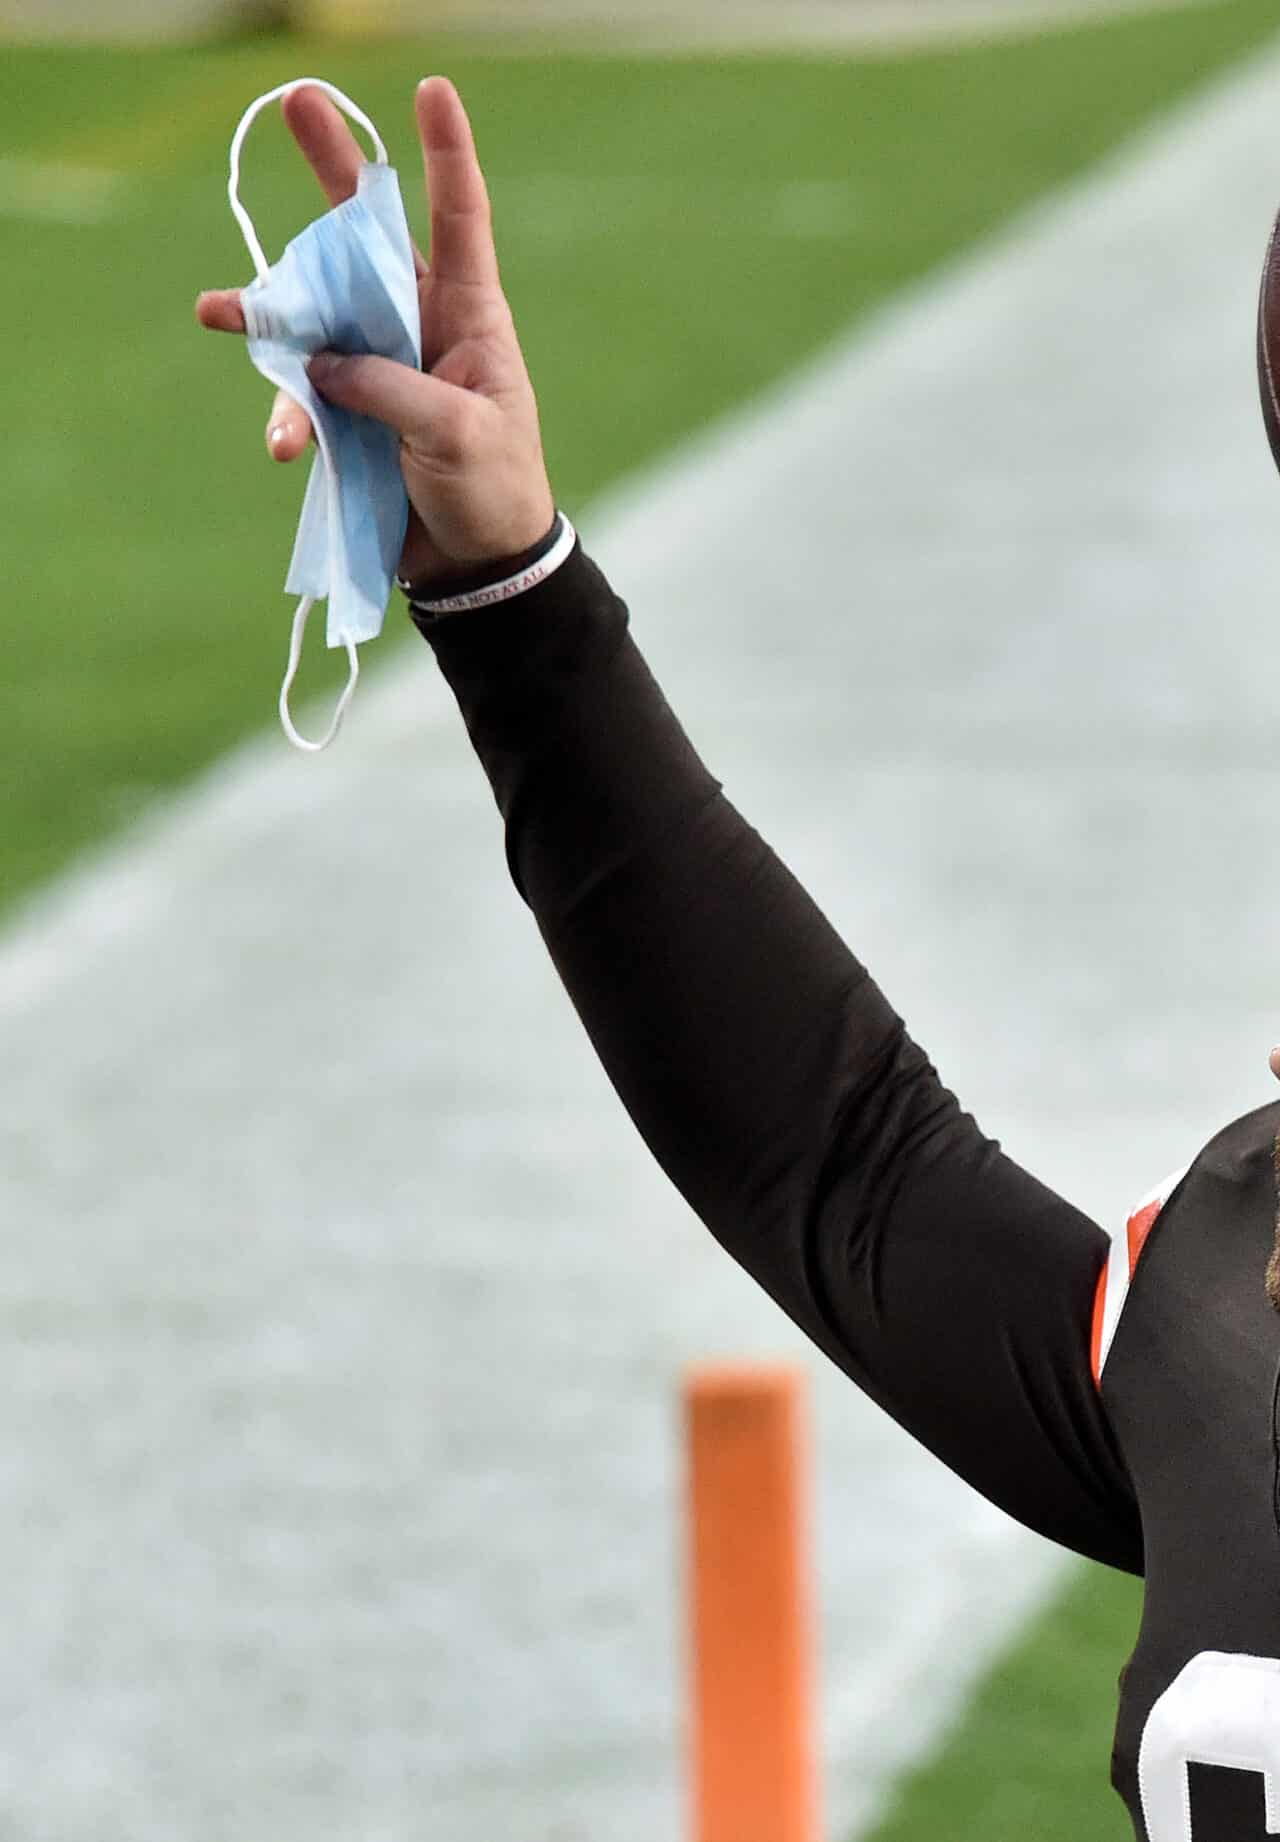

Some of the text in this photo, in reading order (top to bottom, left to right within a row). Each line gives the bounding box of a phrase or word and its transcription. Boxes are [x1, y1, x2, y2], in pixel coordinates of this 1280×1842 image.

[469, 591, 499, 609] NOT
[502, 582, 521, 597] AT
[522, 567, 548, 590] ALL
